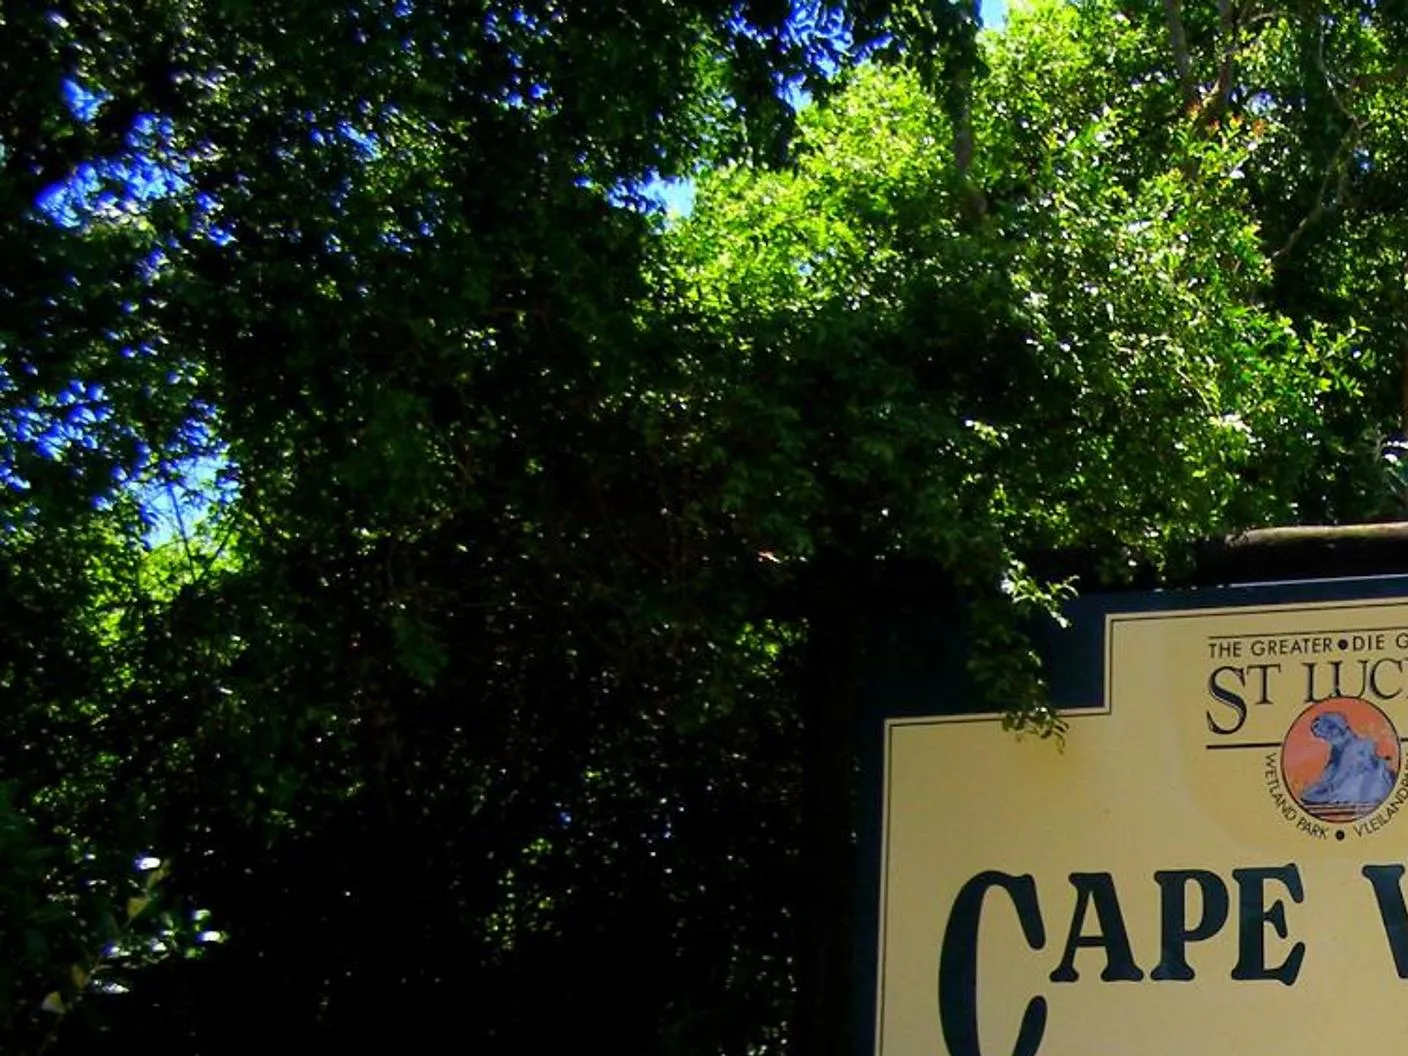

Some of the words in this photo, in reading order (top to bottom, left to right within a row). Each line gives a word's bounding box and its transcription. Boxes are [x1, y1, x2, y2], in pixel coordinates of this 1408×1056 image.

[1209, 642, 1242, 658] THE
[1250, 637, 1332, 656] GREATER
[1352, 634, 1385, 650] DIE
[1206, 662, 1281, 735] ST
[1265, 752, 1297, 822] WETLAND
[1296, 818, 1329, 840] PARK
